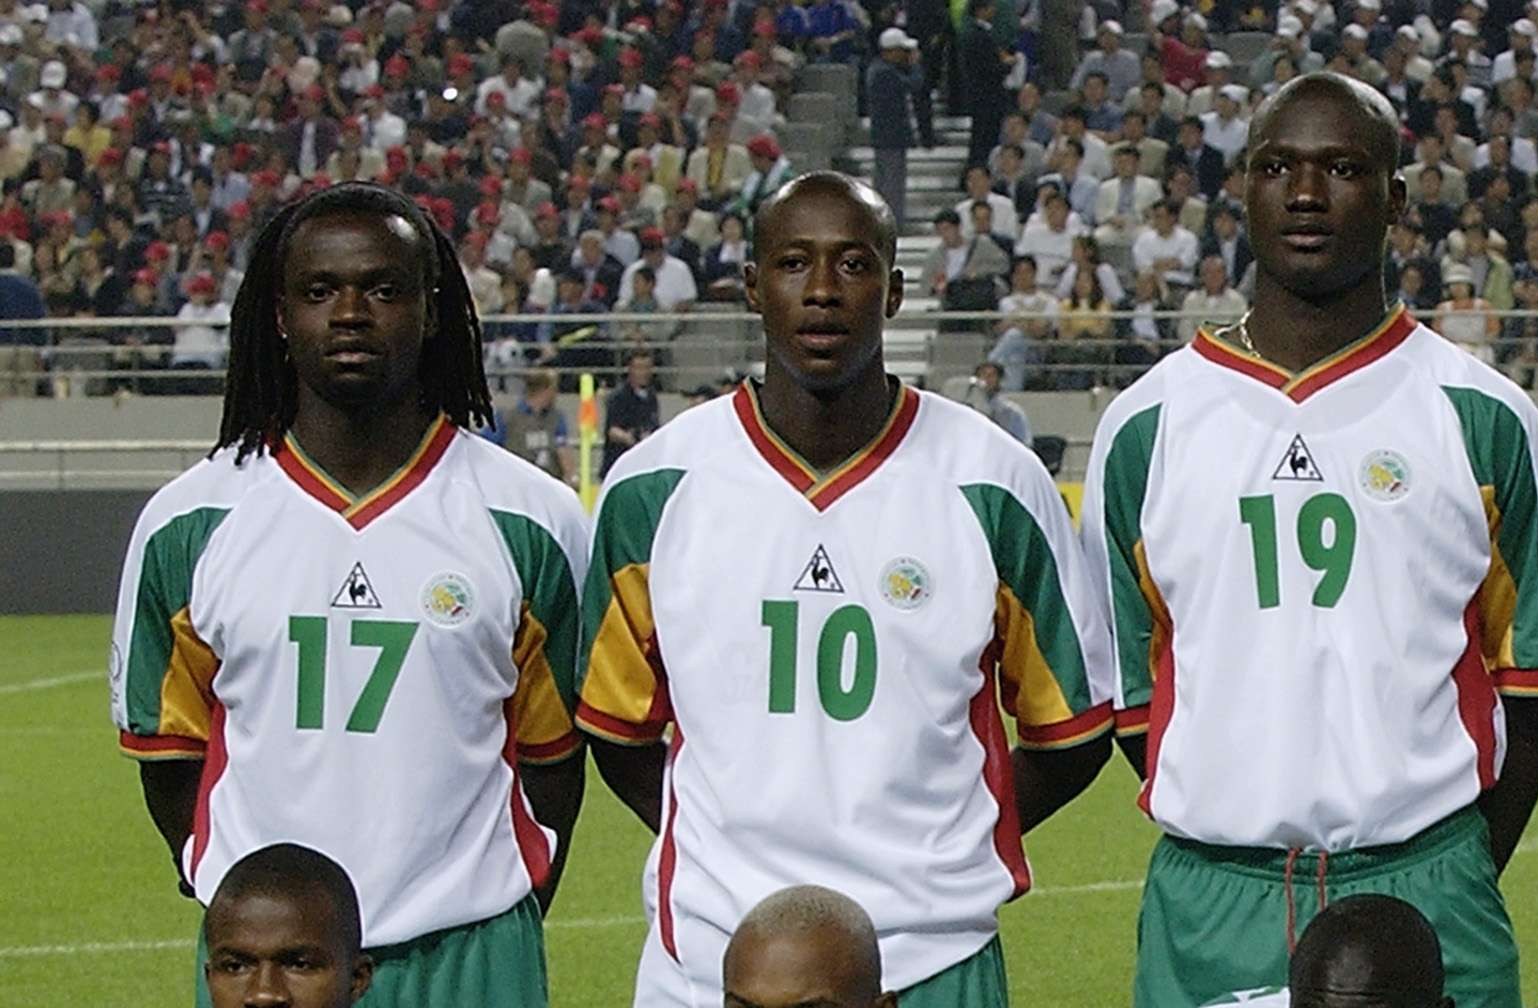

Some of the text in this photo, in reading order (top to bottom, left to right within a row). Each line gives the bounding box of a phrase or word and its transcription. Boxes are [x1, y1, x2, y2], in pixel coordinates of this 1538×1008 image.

[1239, 493, 1356, 608] 19
[289, 616, 419, 732] 17
[762, 601, 877, 721] 10
